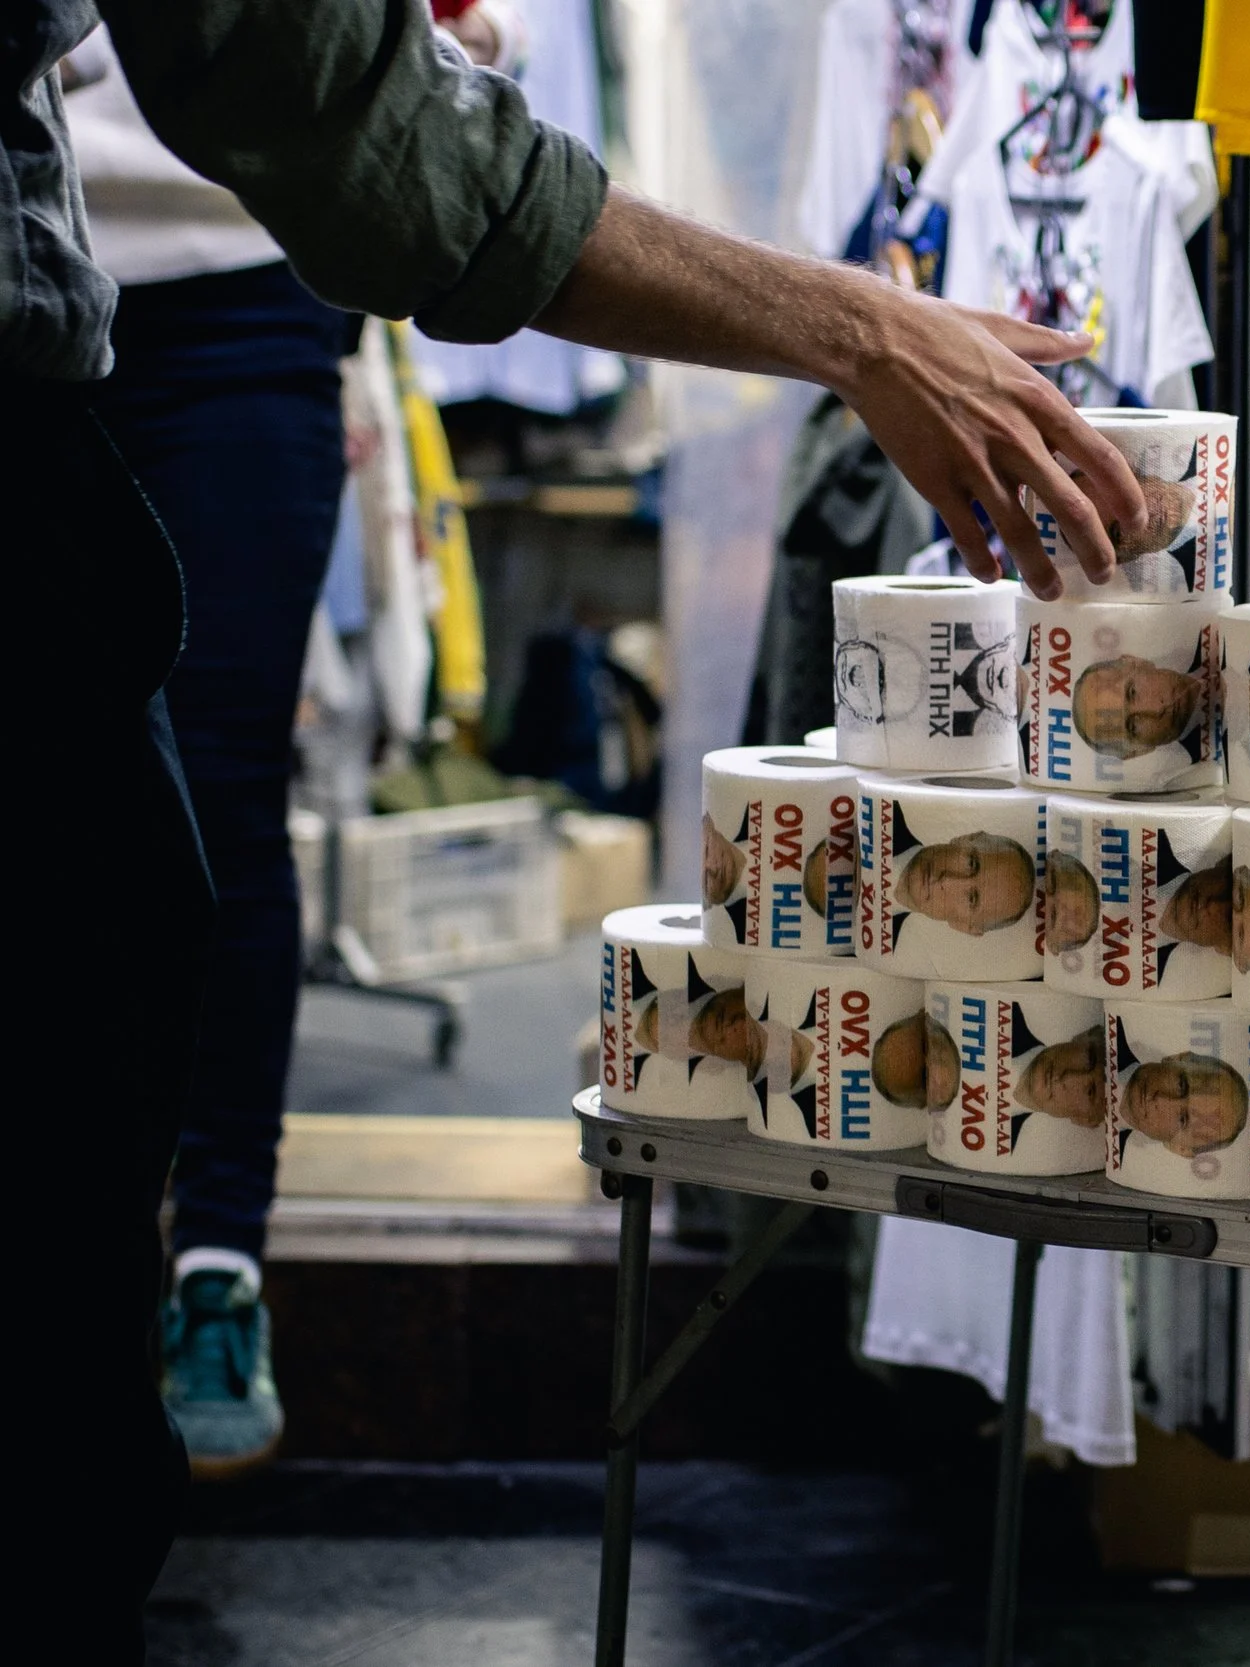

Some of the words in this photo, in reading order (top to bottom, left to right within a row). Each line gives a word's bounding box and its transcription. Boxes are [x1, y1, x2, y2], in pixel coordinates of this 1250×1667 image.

[1213, 516, 1228, 589] ПТН
[929, 622, 950, 674] ПТН
[928, 683, 950, 739] ПНХ
[1047, 708, 1072, 782] ПТН
[861, 795, 874, 870] ПТН
[1101, 828, 1130, 904] ПТН
[771, 883, 802, 949] ПТН
[826, 874, 854, 945] ПТН
[603, 942, 616, 1013] ПТН
[961, 996, 987, 1072] ПТН
[840, 1069, 870, 1140] ПТН
